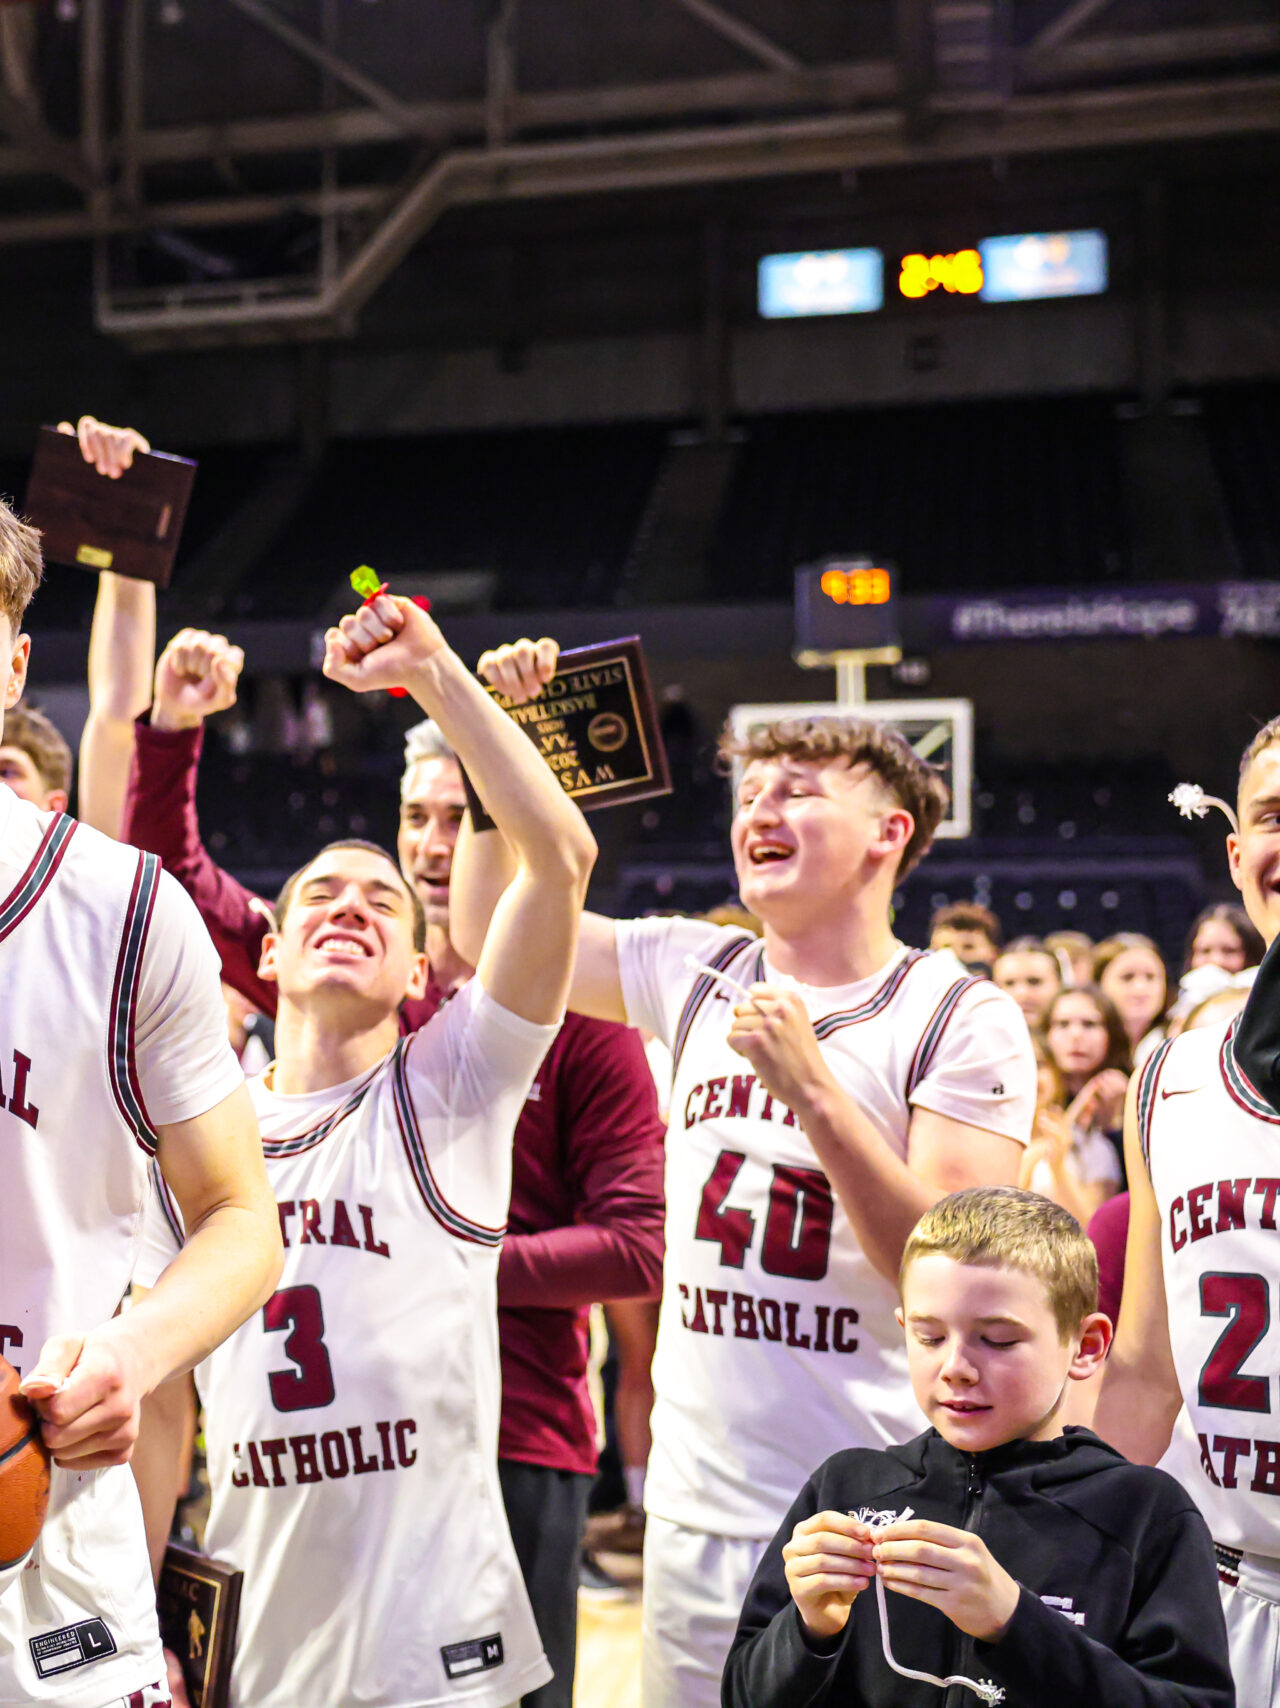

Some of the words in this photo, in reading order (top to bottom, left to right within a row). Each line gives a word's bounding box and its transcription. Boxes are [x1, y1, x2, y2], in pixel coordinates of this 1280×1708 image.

[276, 1198, 391, 1260] TRAL
[694, 1149, 835, 1281] 40
[1169, 1177, 1280, 1254] CENT
[262, 1284, 336, 1413] 3
[87, 1632, 102, 1648] L
